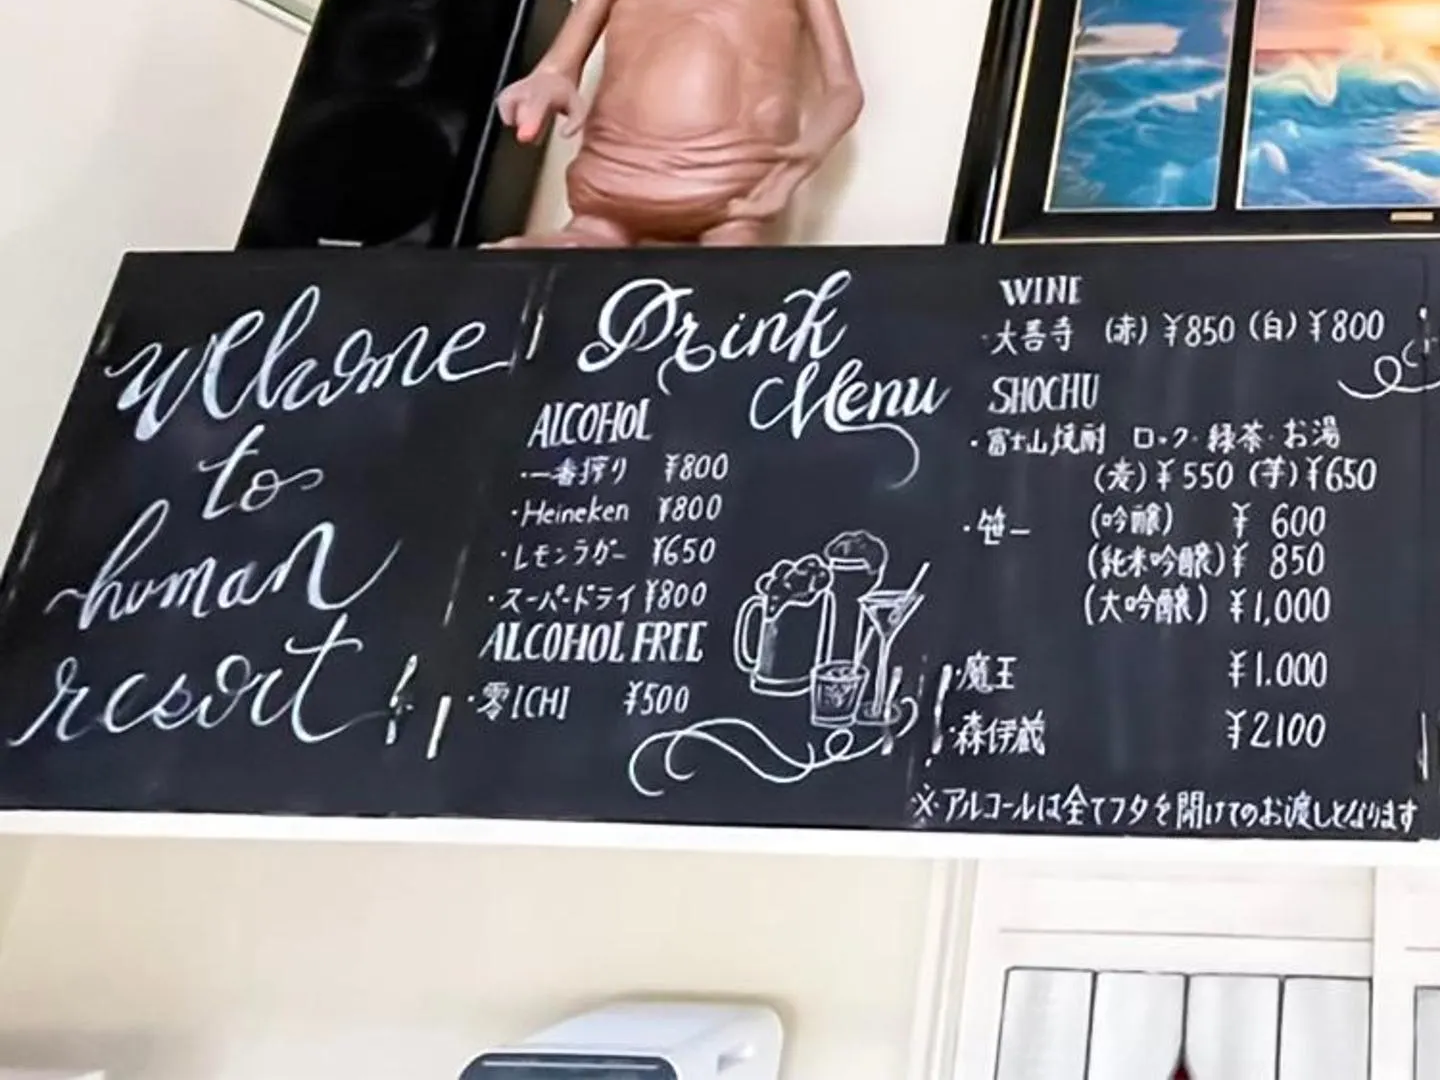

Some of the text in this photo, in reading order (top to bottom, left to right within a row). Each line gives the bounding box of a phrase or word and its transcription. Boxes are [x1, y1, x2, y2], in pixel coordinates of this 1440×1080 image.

[998, 275, 1083, 306] WINE
[577, 269, 852, 395] Drink
[1163, 313, 1235, 348] ¥850
[1308, 309, 1385, 343] ¥800
[104, 286, 512, 441] Welcome
[988, 373, 1100, 414] SHOCHU
[527, 398, 653, 449] ALCOHOL
[749, 357, 953, 489] Menu
[197, 425, 324, 519] to
[665, 453, 728, 482] ¥800
[1156, 458, 1234, 492] ¥550
[1306, 456, 1377, 492] ¥650
[520, 494, 723, 528] Heineken ¥800
[43, 500, 402, 630] human
[653, 534, 716, 567] ¥650
[500, 579, 707, 614] スーパードライ ¥800
[478, 621, 708, 663] ALCOHOL FREE
[8, 614, 385, 742] resort
[623, 679, 690, 716] ¥500
